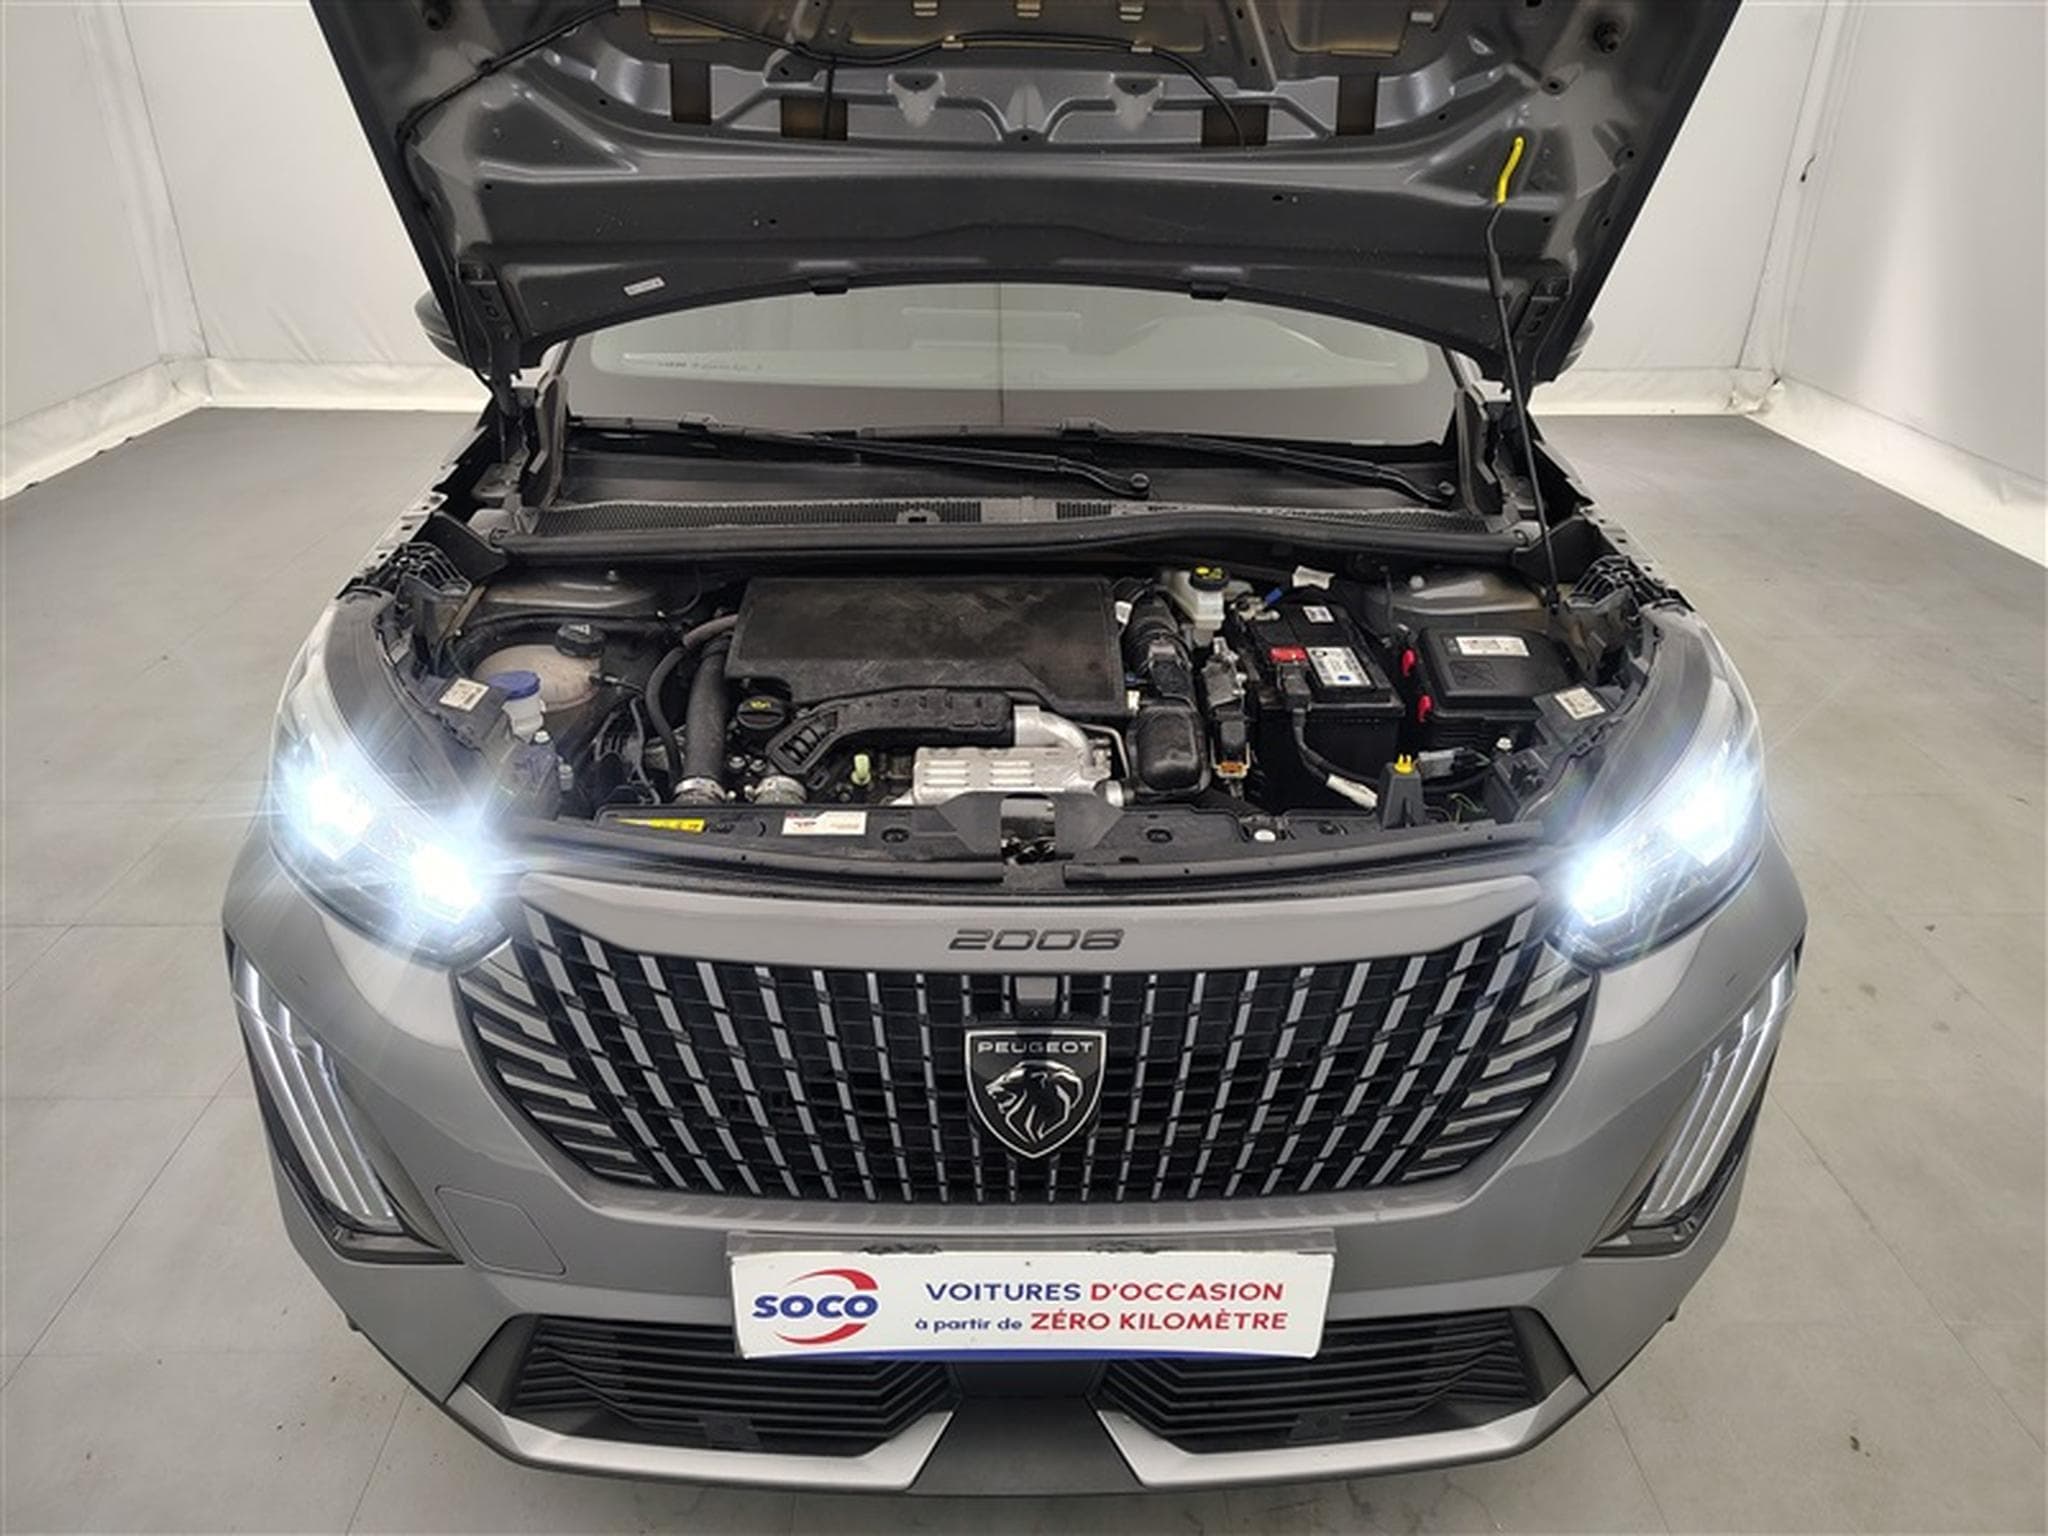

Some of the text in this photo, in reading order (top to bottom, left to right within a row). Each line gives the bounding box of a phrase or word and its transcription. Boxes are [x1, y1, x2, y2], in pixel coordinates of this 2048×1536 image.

[949, 929, 1125, 950] 2008
[976, 1041, 1094, 1054] PEUGEOT
[925, 1283, 1284, 1301] VOITURES D'OCCASION
[752, 1294, 879, 1319] SOCO
[915, 1308, 1289, 1333] à partir de ZÉRO KILOMÈTRE
